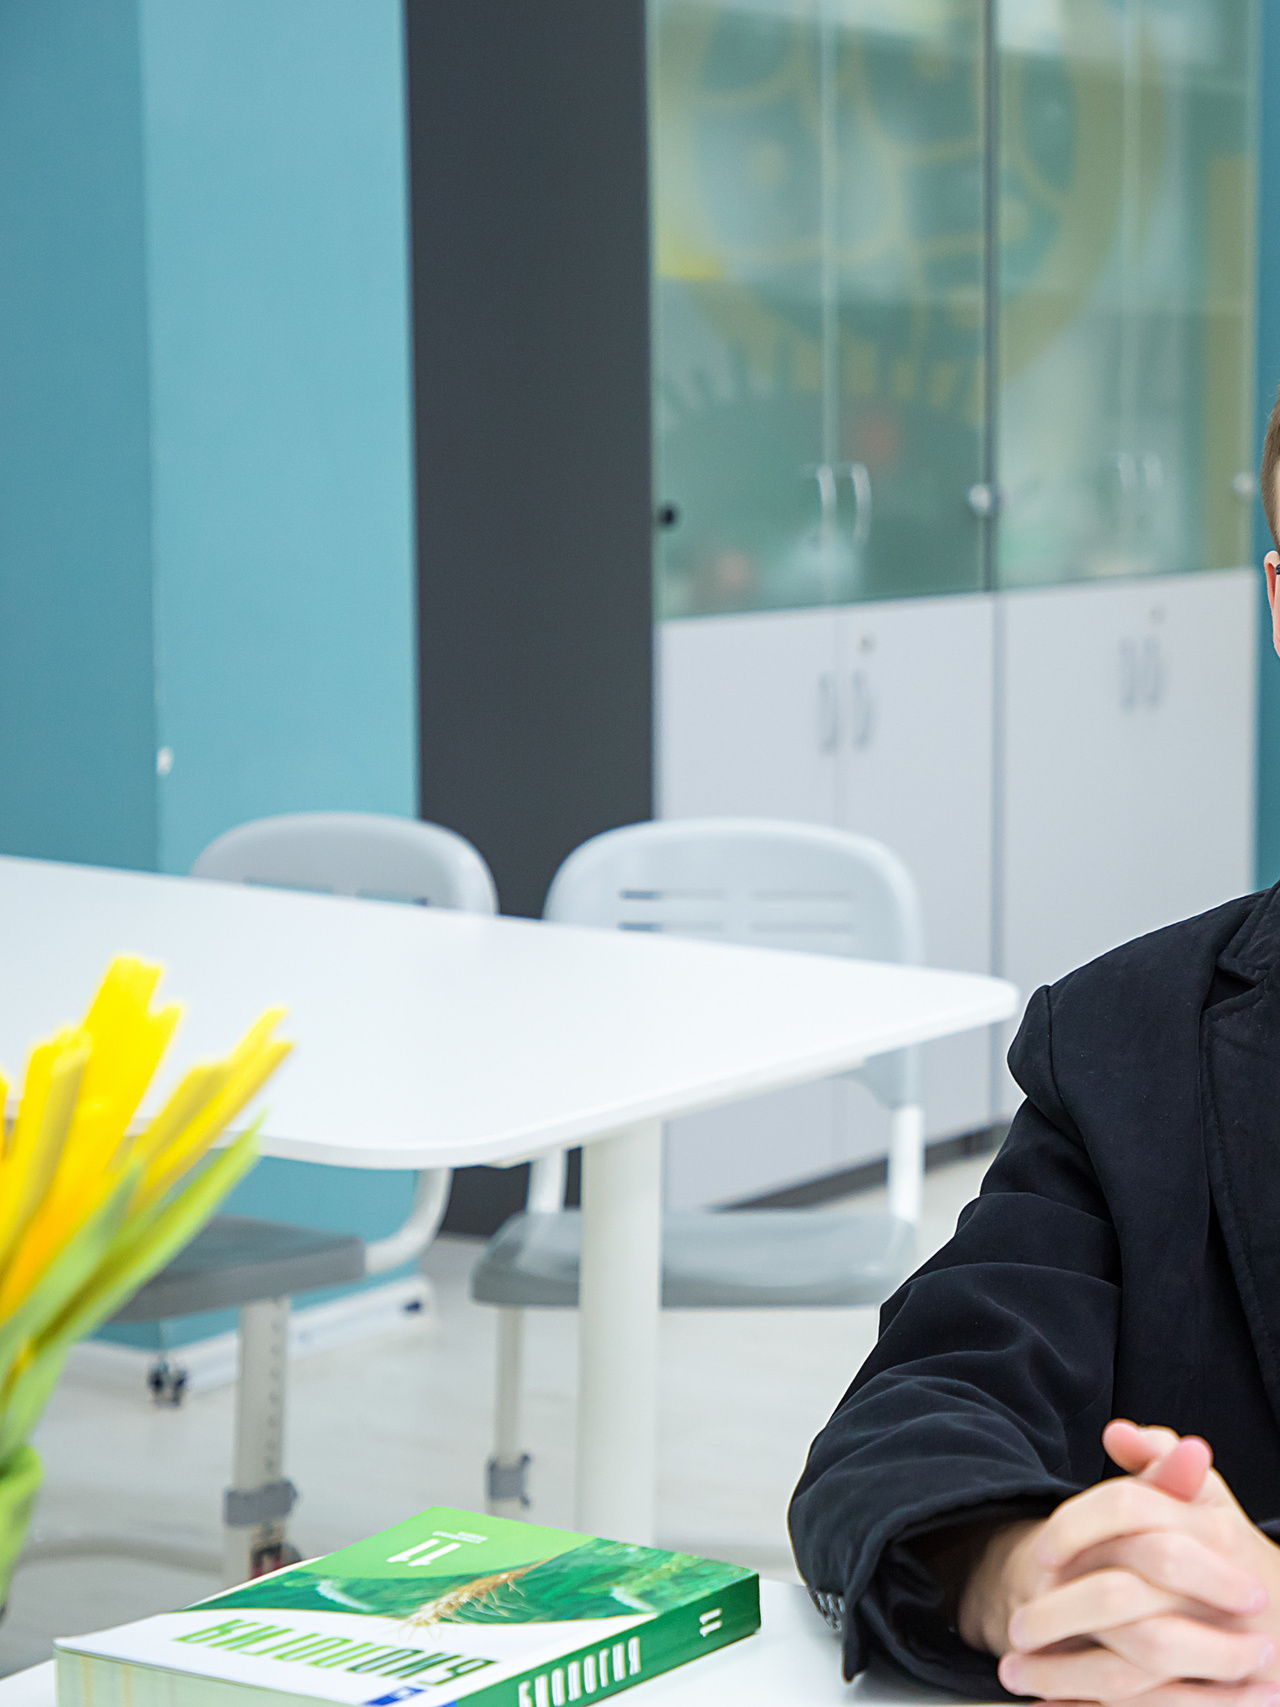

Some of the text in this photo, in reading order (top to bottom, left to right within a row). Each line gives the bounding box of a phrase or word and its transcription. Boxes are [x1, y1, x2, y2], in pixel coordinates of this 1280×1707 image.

[386, 1538, 462, 1568] 11
[698, 1607, 723, 1638] 11
[171, 1618, 500, 1687] БИОЛОГИЯ
[518, 1635, 642, 1707] БИОЛОГИЯ
